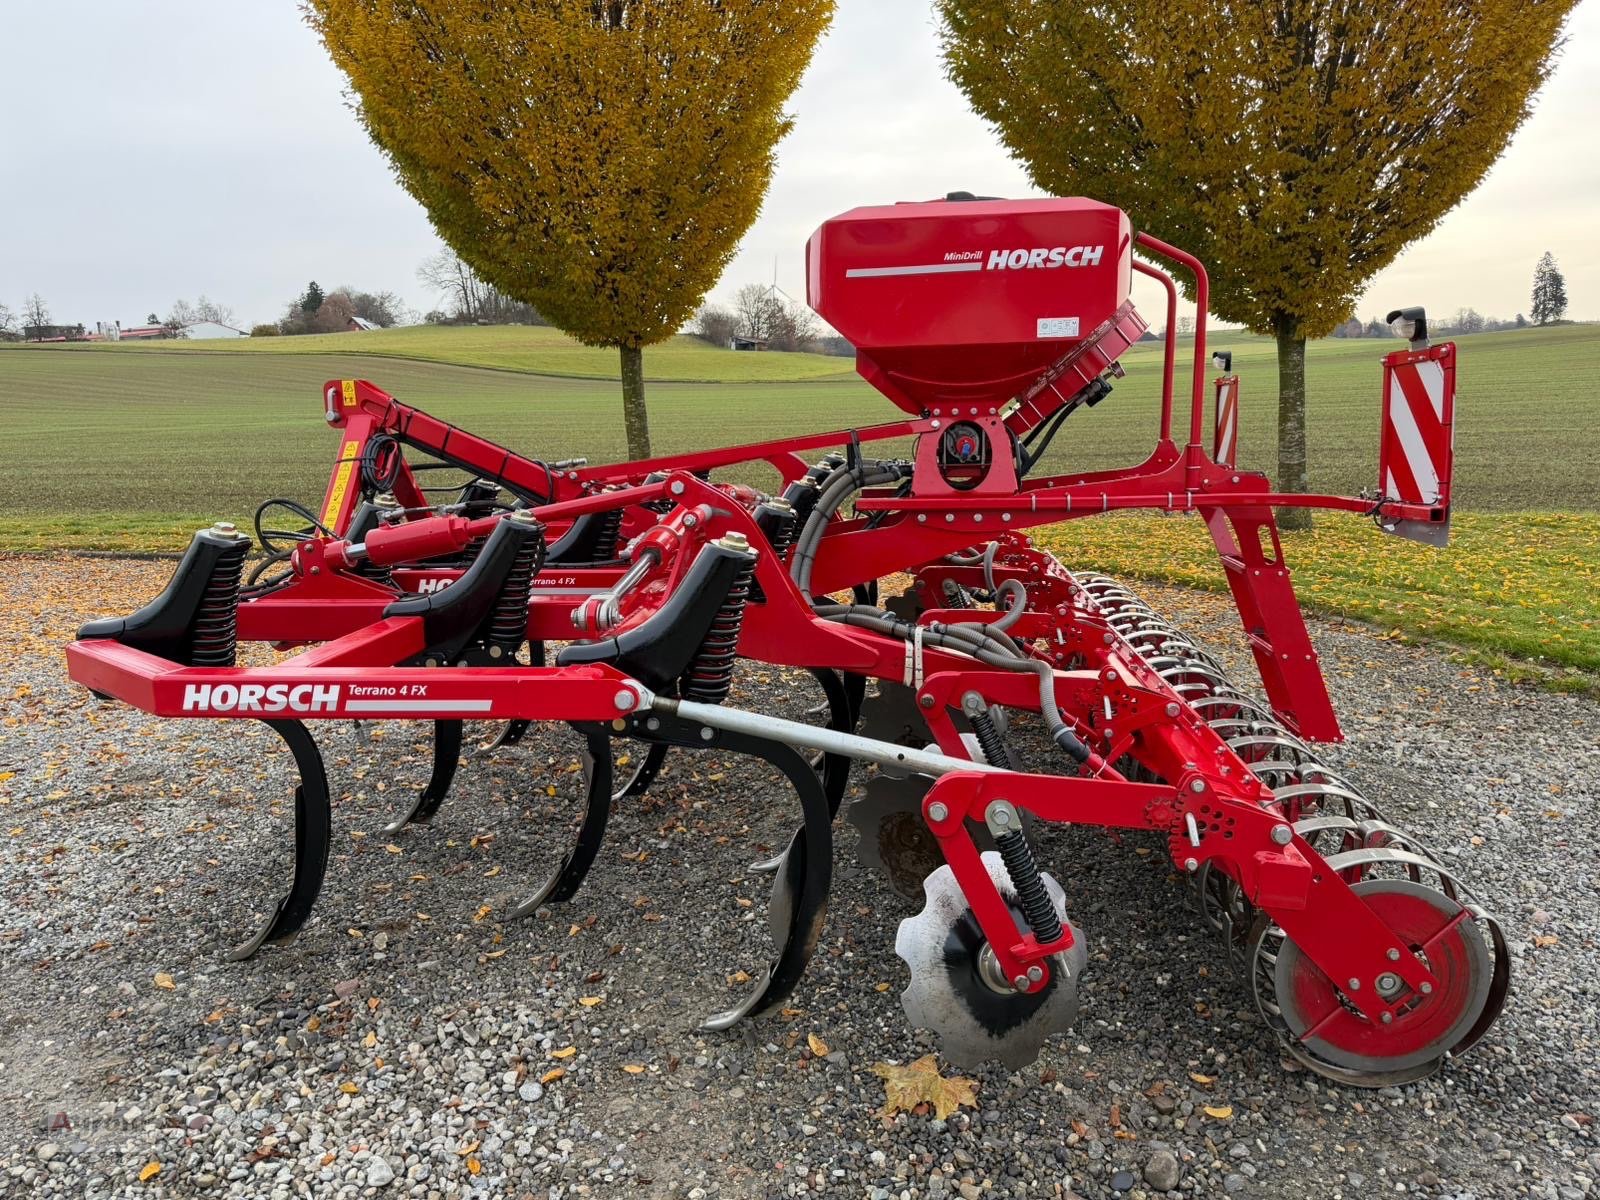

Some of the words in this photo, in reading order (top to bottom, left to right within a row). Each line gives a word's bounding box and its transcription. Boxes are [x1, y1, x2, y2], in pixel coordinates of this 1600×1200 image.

[943, 250, 983, 261] MiniDrill
[987, 245, 1105, 270] HORSCH
[565, 577, 576, 585] FX
[182, 684, 341, 712] HORSCH
[348, 684, 396, 696] Terrano
[400, 685, 408, 696] 4
[410, 685, 428, 696] FX
